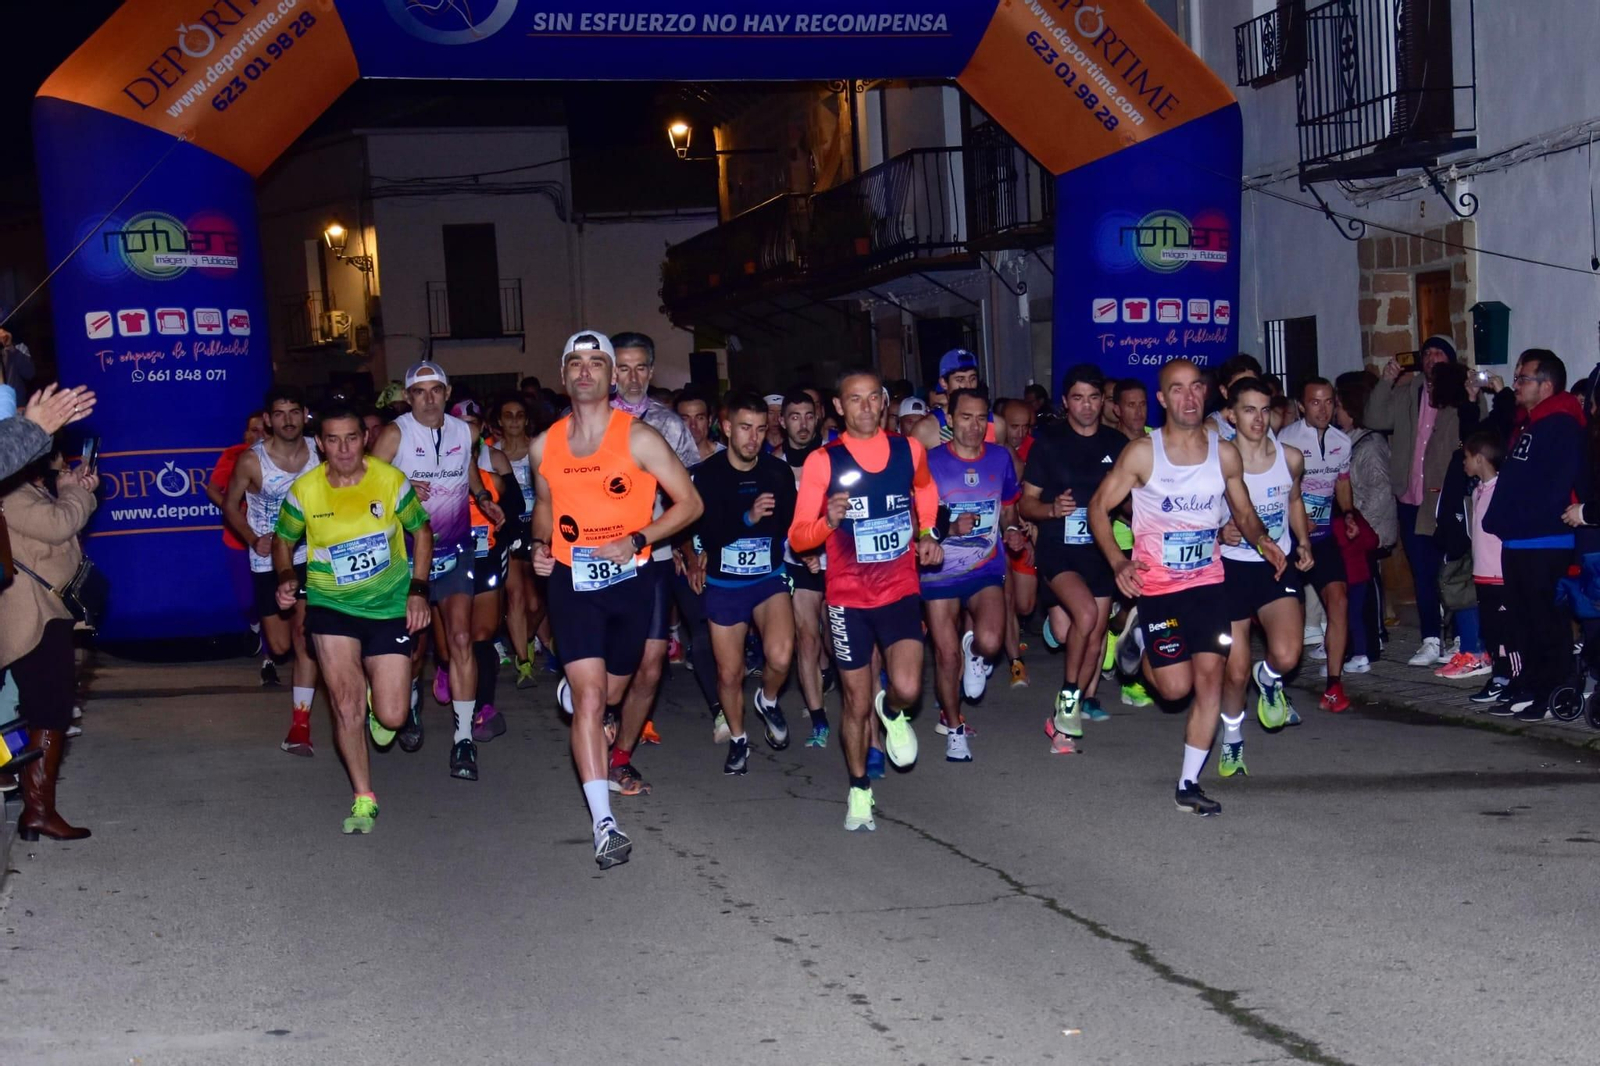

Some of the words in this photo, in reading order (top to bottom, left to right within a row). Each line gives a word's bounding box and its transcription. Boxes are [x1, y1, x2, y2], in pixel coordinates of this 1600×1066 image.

[533, 12, 574, 31] SIN
[580, 12, 697, 32] ESFUERZO
[702, 12, 738, 32] NO
[743, 13, 791, 33] HAY
[795, 13, 949, 33] RECOMPENSA
[211, 77, 249, 112] 623
[245, 57, 271, 81] 01
[266, 32, 294, 60] 98
[288, 11, 317, 38] 28
[1025, 31, 1059, 66] 623
[1055, 62, 1077, 88] 01
[1075, 84, 1100, 110] 98
[1094, 105, 1120, 132] 28
[1142, 354, 1163, 365] 661
[1191, 355, 1208, 365] 071
[147, 370, 171, 381] 661
[175, 369, 202, 381] 848
[206, 369, 227, 380] 071
[563, 465, 601, 474] GIVOVA
[1174, 494, 1215, 512] Salud
[583, 524, 624, 533] MAXIMETAL
[872, 532, 899, 552] 109
[347, 551, 377, 573] 231
[738, 551, 757, 566] 82
[1180, 543, 1203, 562] 174
[586, 561, 622, 580] 383
